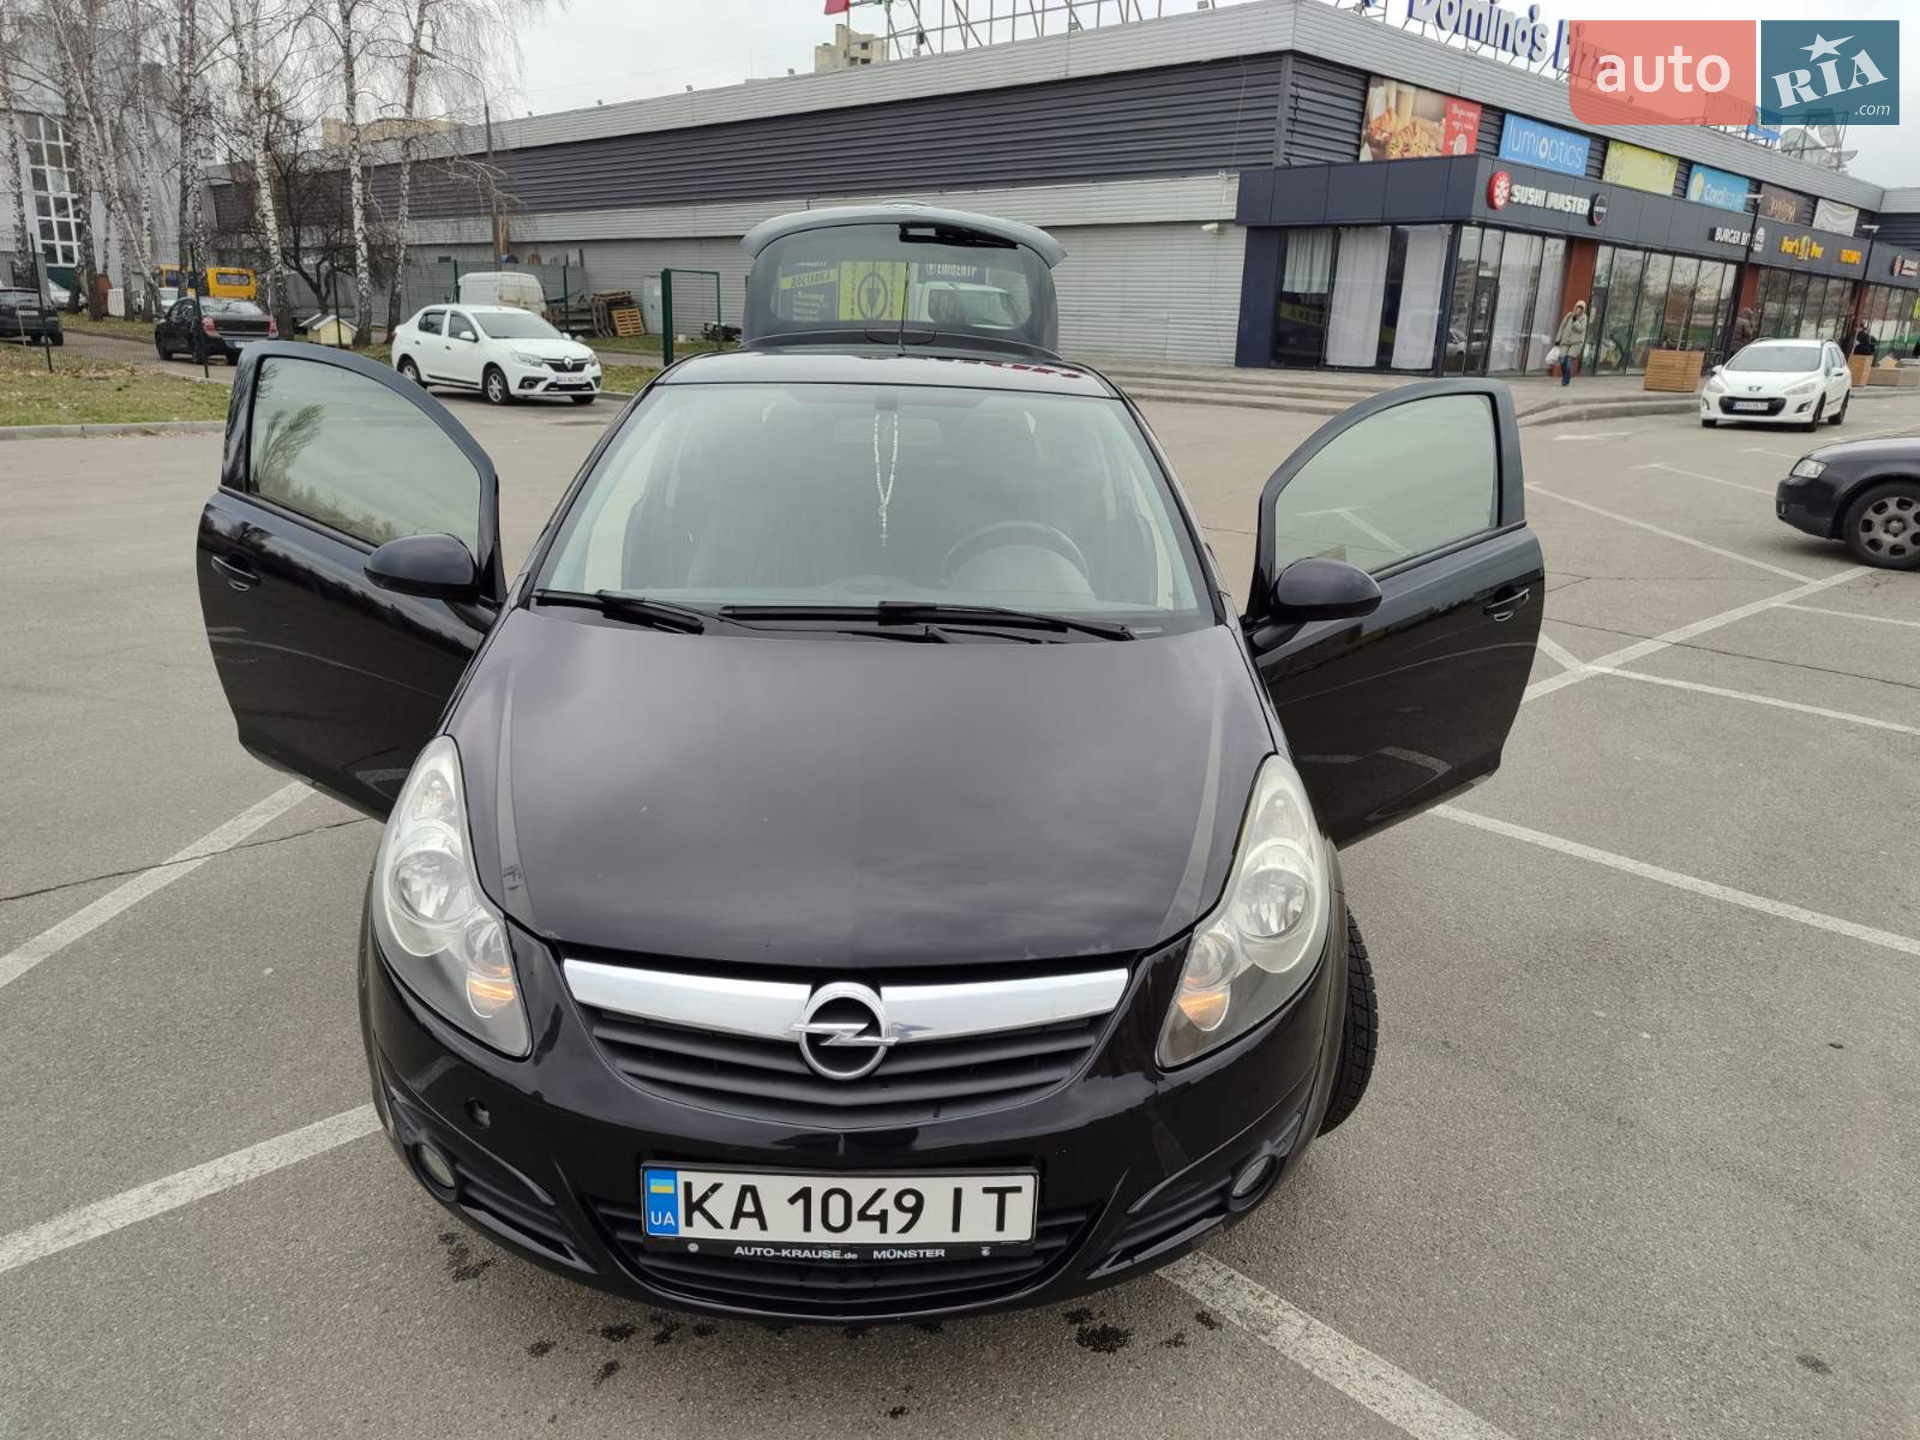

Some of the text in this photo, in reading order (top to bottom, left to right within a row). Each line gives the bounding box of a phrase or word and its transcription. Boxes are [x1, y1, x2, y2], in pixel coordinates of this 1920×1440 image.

[1508, 117, 1583, 169] lumioptics
[1510, 184, 1591, 216] SUSHI MASTER
[1714, 226, 1741, 245] BURGER
[650, 1211, 676, 1226] UA
[684, 1181, 1022, 1234] KA 1049 IT
[733, 1246, 945, 1259] AUTO-KRAUSE.de MÜNSTER
